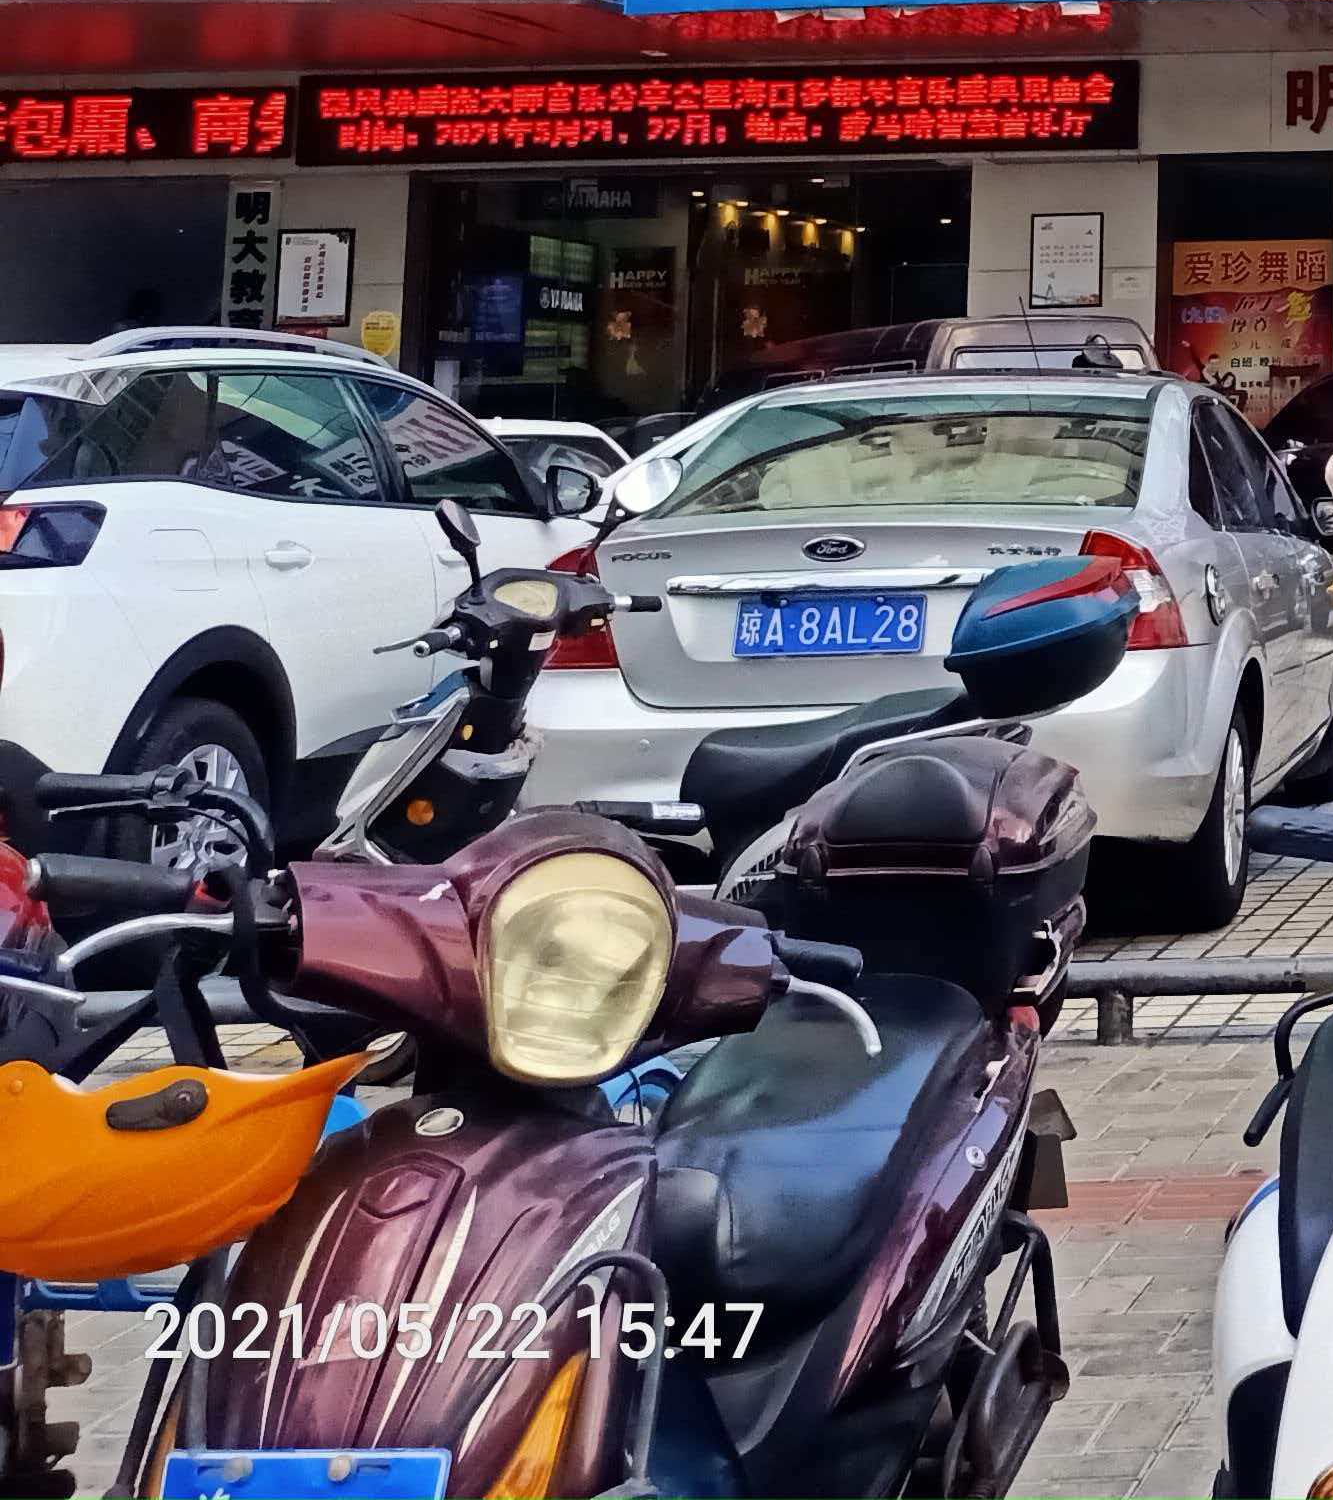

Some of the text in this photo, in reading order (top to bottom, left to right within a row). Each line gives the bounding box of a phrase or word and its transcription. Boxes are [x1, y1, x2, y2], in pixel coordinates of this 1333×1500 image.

[1183, 250, 1327, 286] 爱珍舞蹈
[814, 541, 852, 556] Ford
[611, 550, 673, 563] FOCUS
